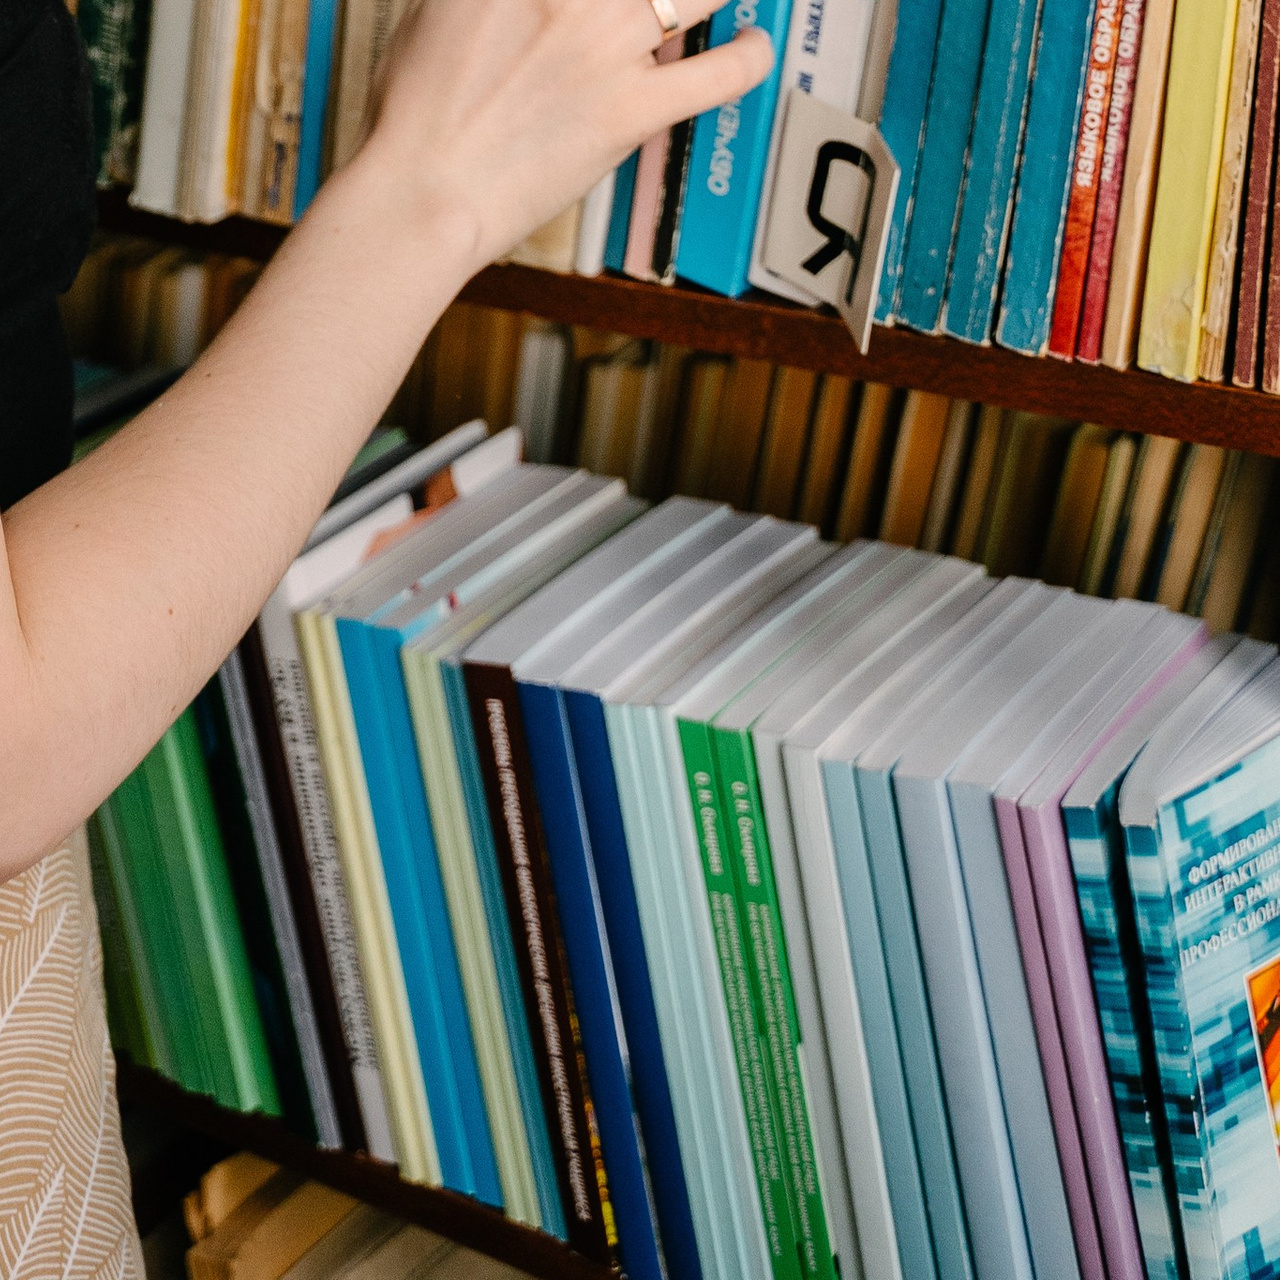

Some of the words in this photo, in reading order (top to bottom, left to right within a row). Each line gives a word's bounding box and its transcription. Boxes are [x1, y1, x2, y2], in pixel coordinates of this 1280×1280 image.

[1075, 68, 1108, 188] ЯЗЫКОВОЕ
[1099, 62, 1131, 182] ЯЗЫКОВОЕ
[800, 139, 876, 304] Я
[1184, 844, 1280, 913] ИНТЕРАКТИВН
[1188, 819, 1280, 886] ФОРМИРОВАН
[1233, 893, 1247, 914] В
